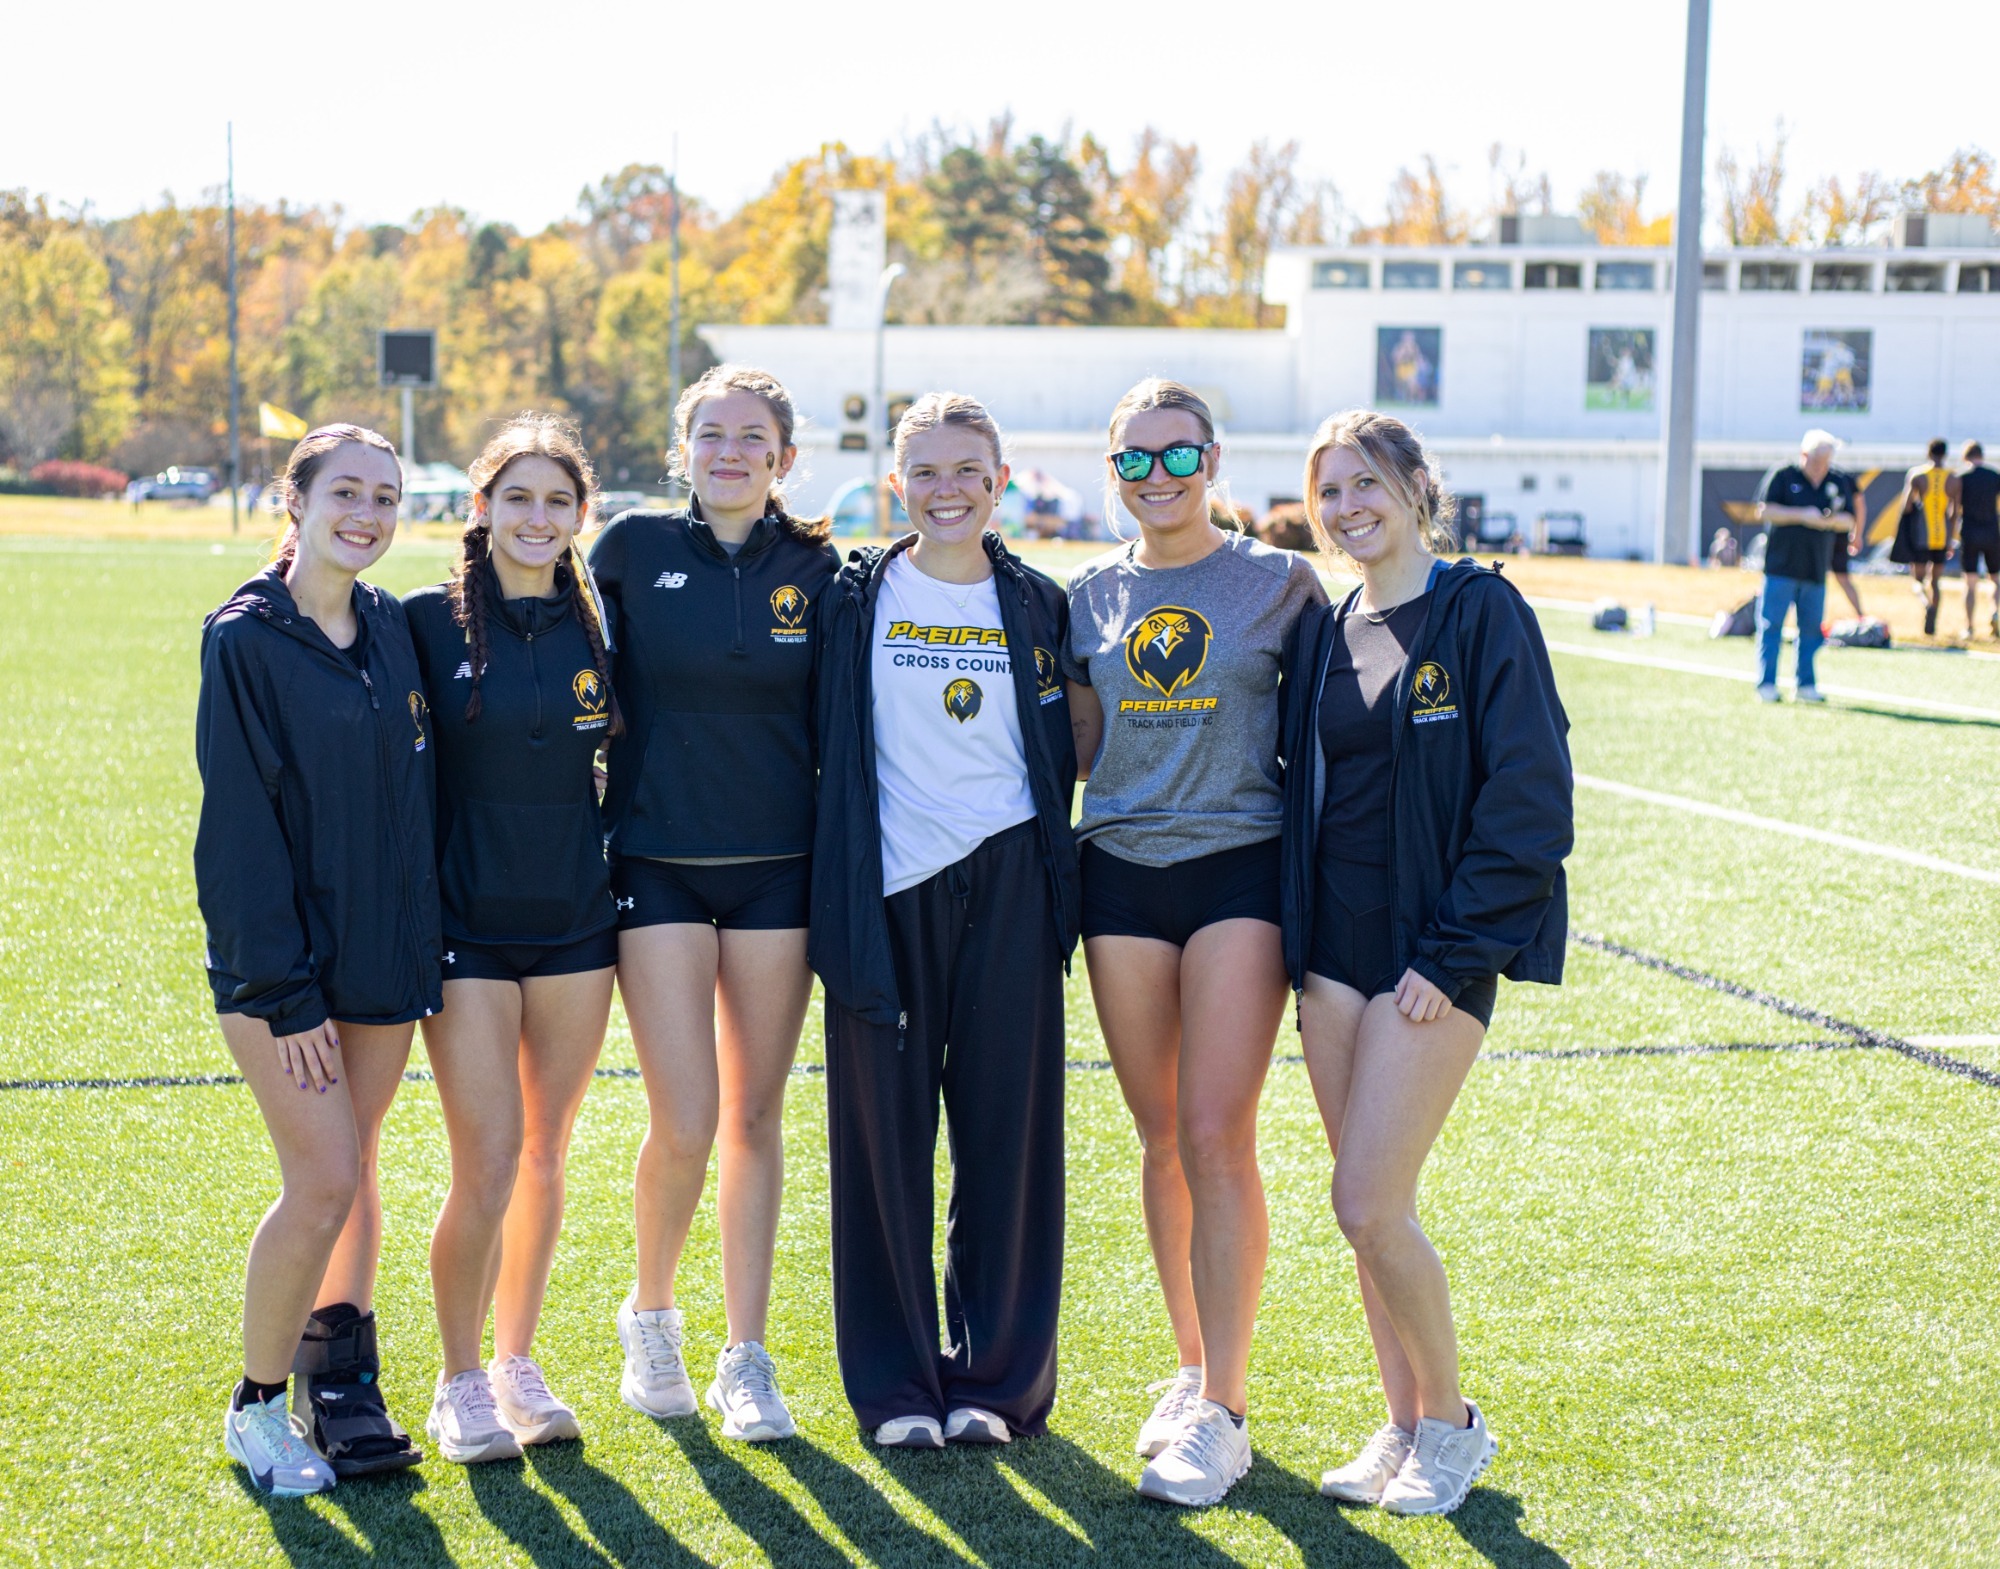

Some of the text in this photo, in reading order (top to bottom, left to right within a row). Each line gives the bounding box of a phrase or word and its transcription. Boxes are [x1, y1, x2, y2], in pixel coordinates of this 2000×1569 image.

[653, 572, 688, 589] NB
[893, 653, 950, 669] CROSS
[1119, 697, 1218, 712] PFEIFFER
[1413, 704, 1456, 716] PFEIFFER
[1127, 718, 1154, 729] TRACK
[1156, 718, 1174, 729] AND
[1175, 717, 1196, 728] FIELD
[1202, 716, 1213, 726] XC
